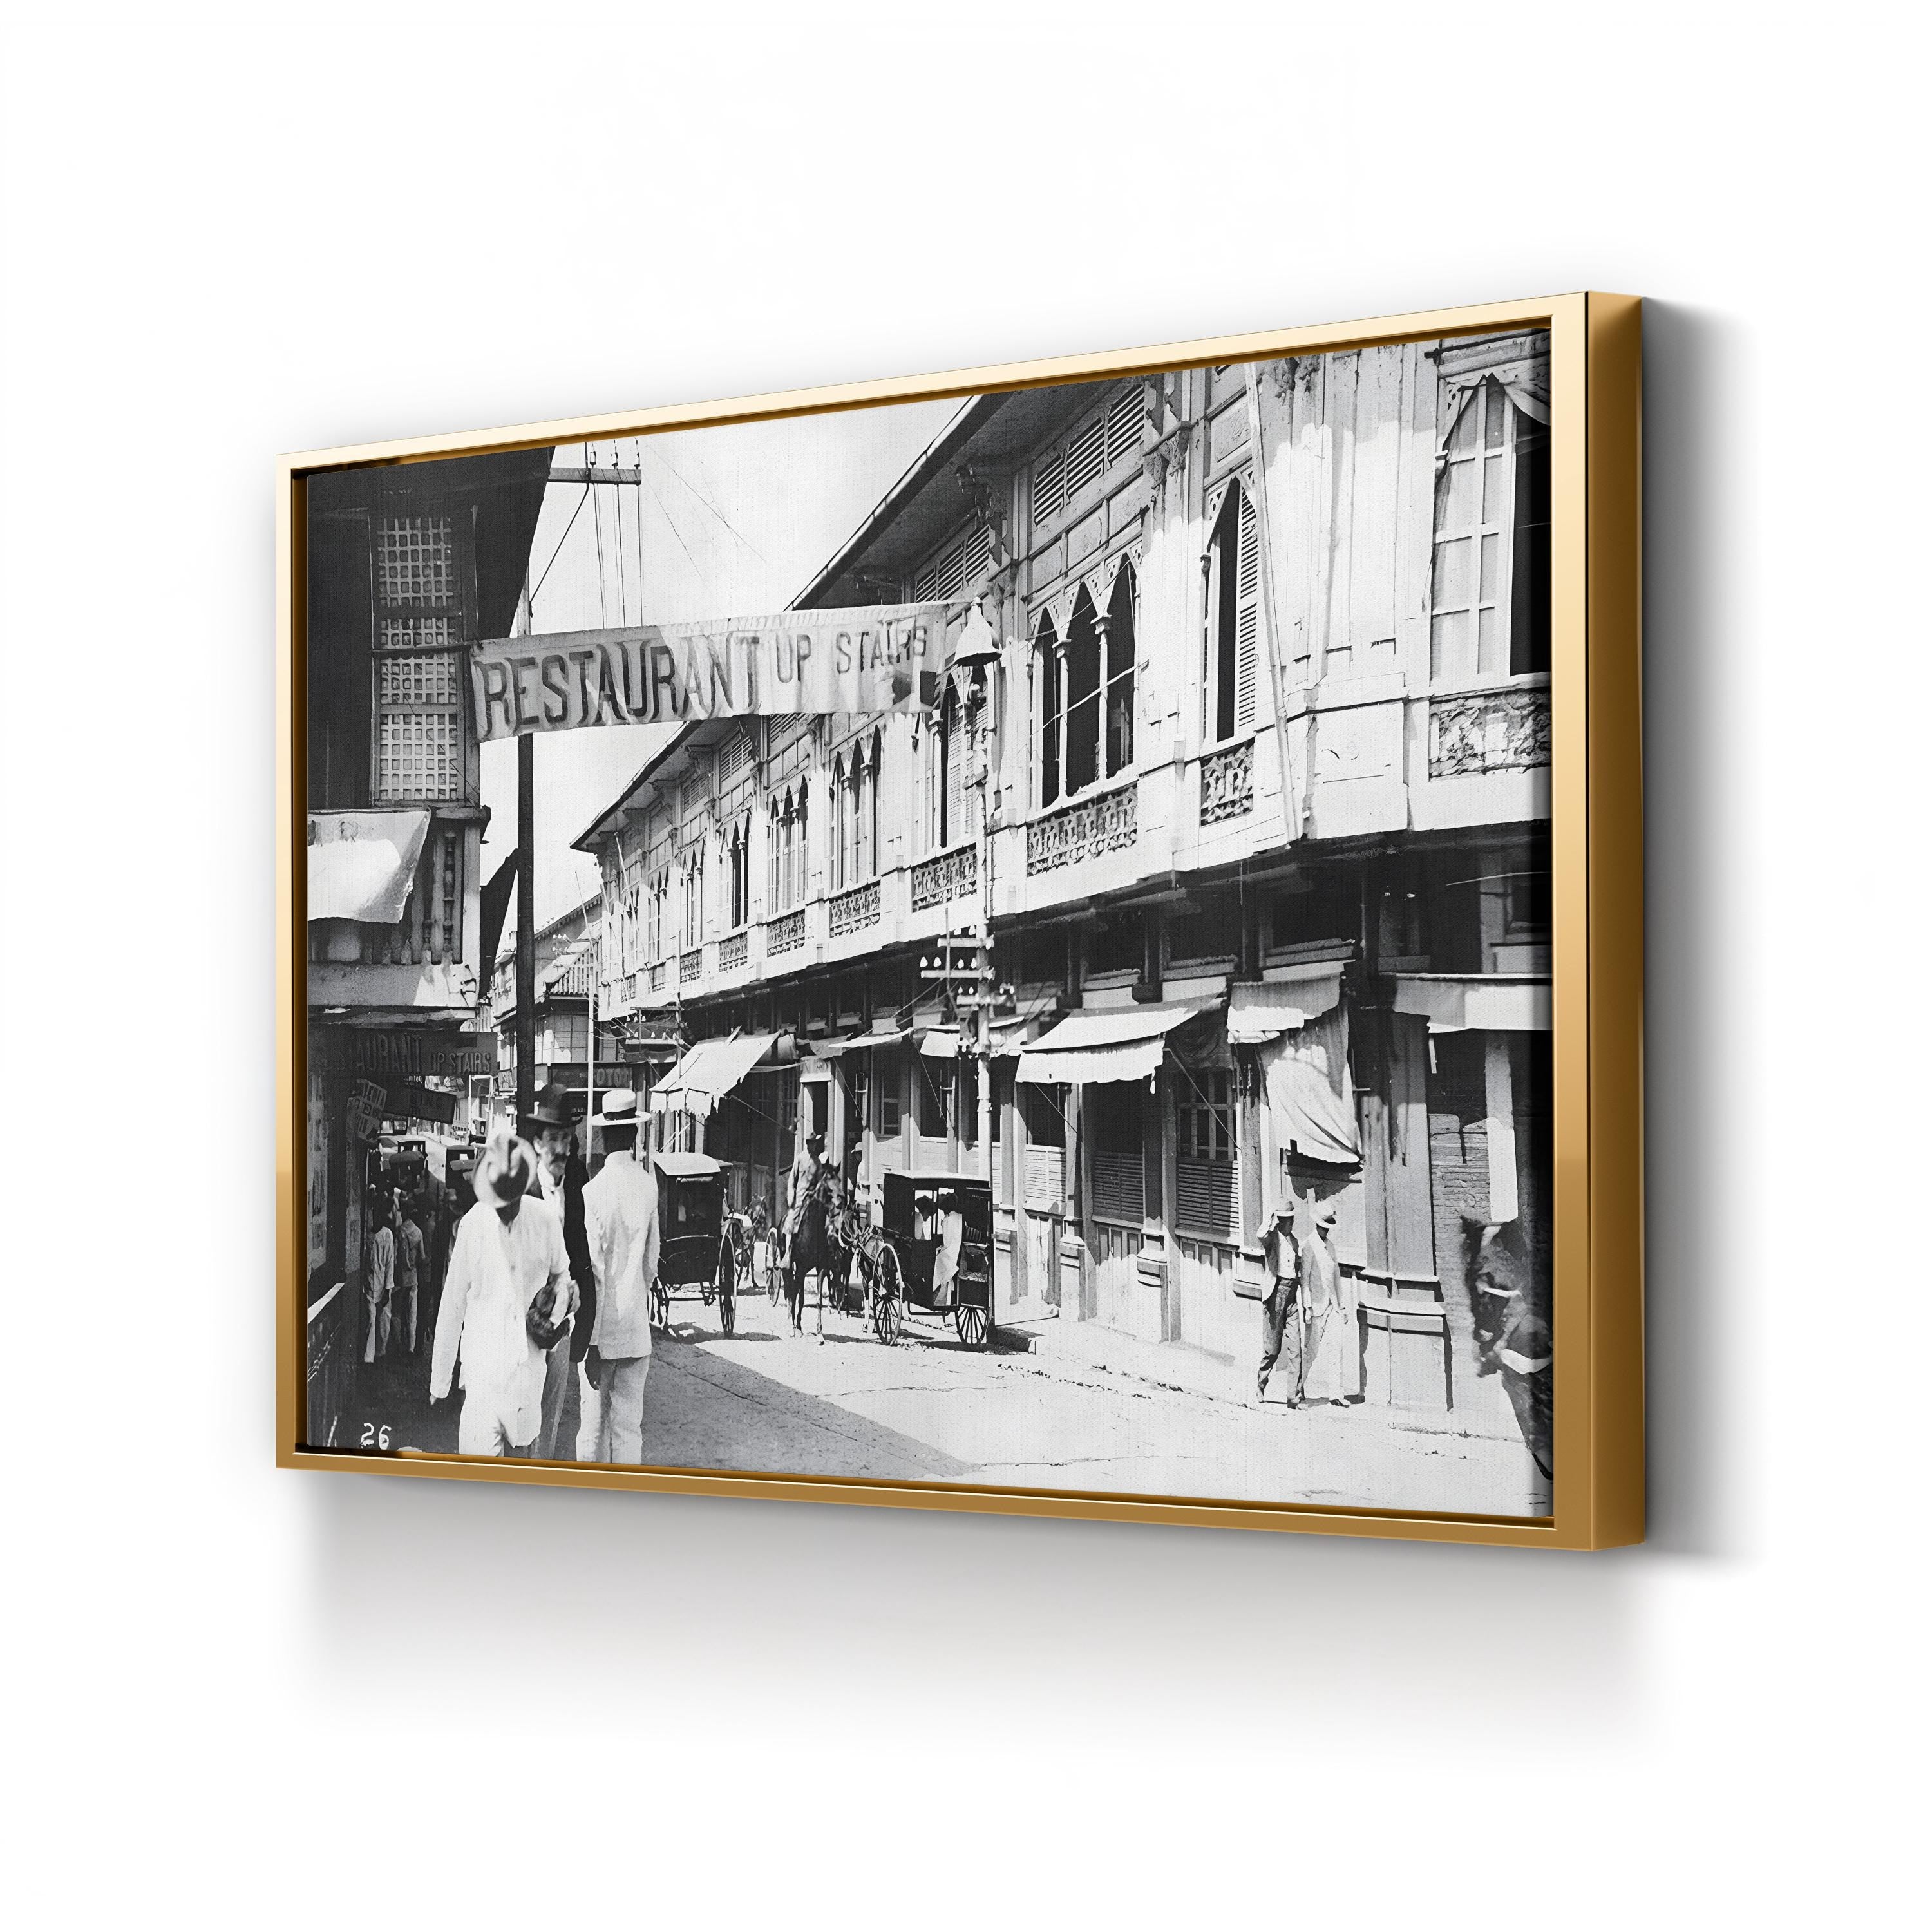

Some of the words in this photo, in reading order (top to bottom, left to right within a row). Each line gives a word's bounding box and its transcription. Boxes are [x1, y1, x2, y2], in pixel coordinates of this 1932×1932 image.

[473, 632, 760, 736] RESTAURANT
[775, 632, 812, 683] UP
[450, 1052, 491, 1074] STAIRS
